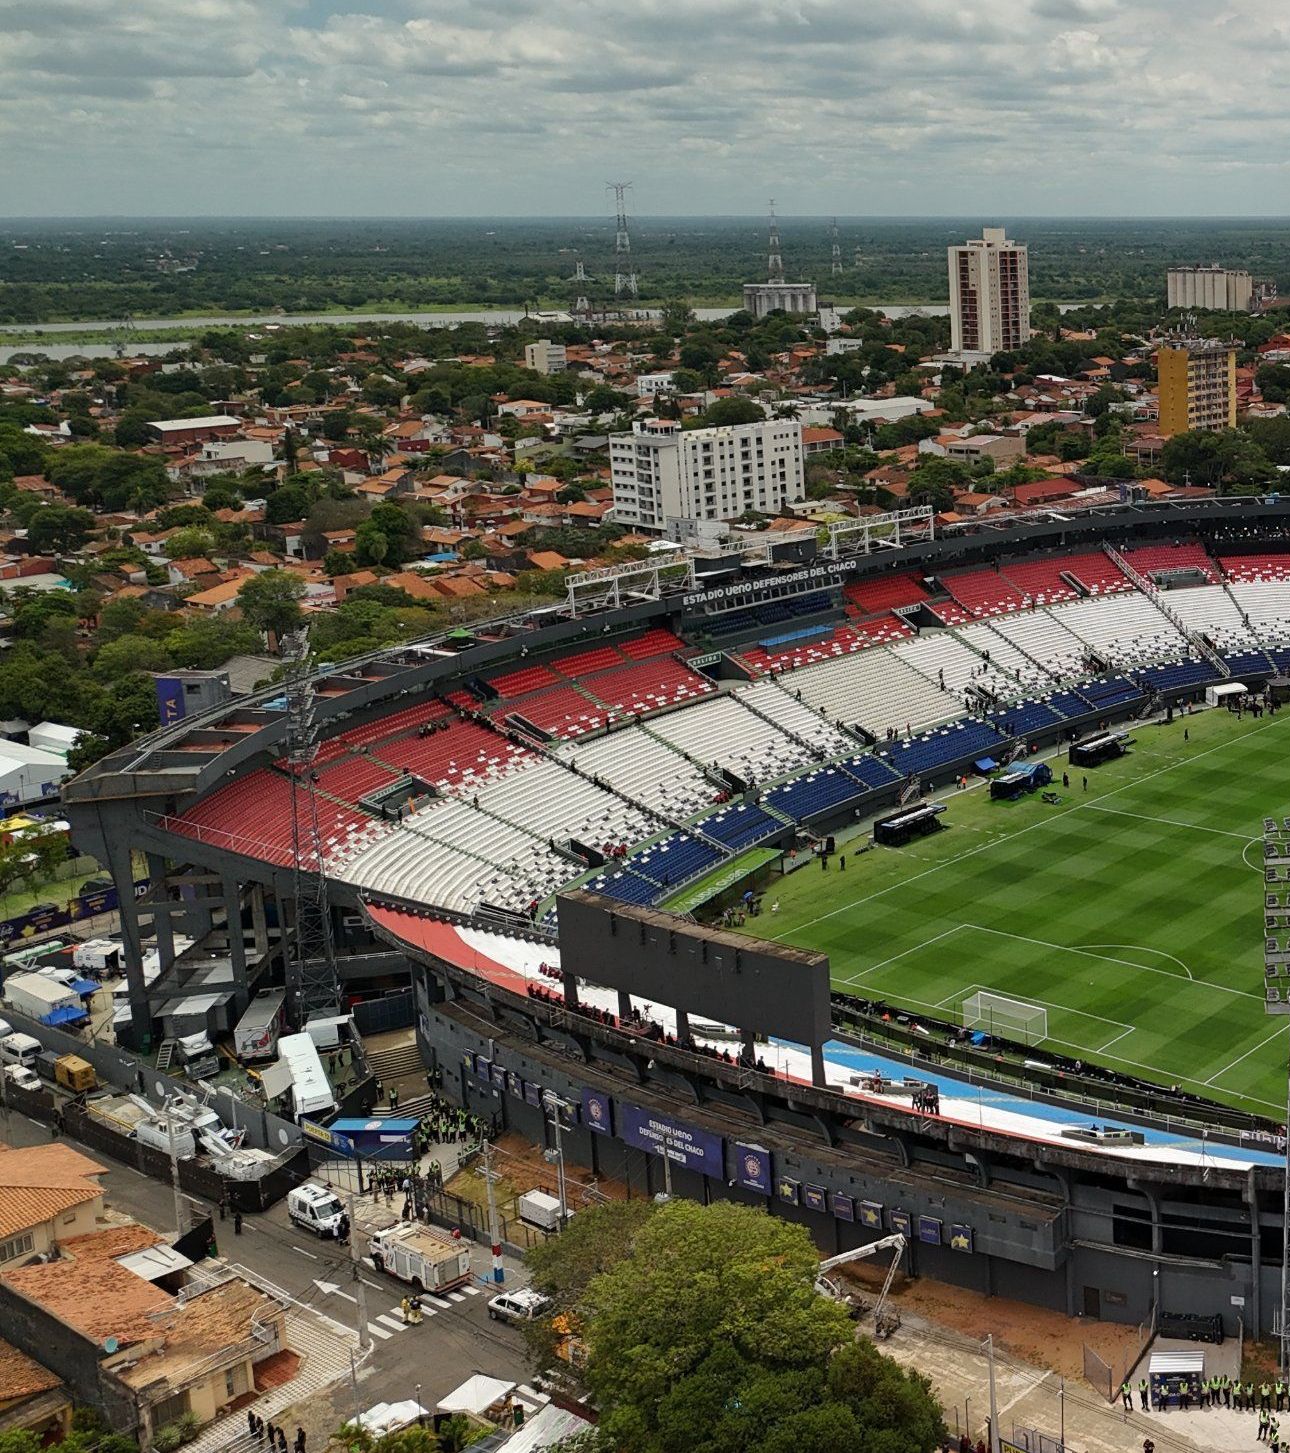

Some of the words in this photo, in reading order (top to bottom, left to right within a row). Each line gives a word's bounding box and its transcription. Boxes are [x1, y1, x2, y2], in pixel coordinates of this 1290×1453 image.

[683, 587, 724, 606] ESTADIO
[753, 570, 810, 591] DEFENSORES
[809, 566, 827, 578] DEL
[827, 560, 857, 575] CHACO
[639, 1126, 673, 1147] DEFENSOES
[673, 1140, 685, 1151] DEL
[685, 1143, 704, 1157] CHACO
[648, 1119, 672, 1134] ESTADIO
